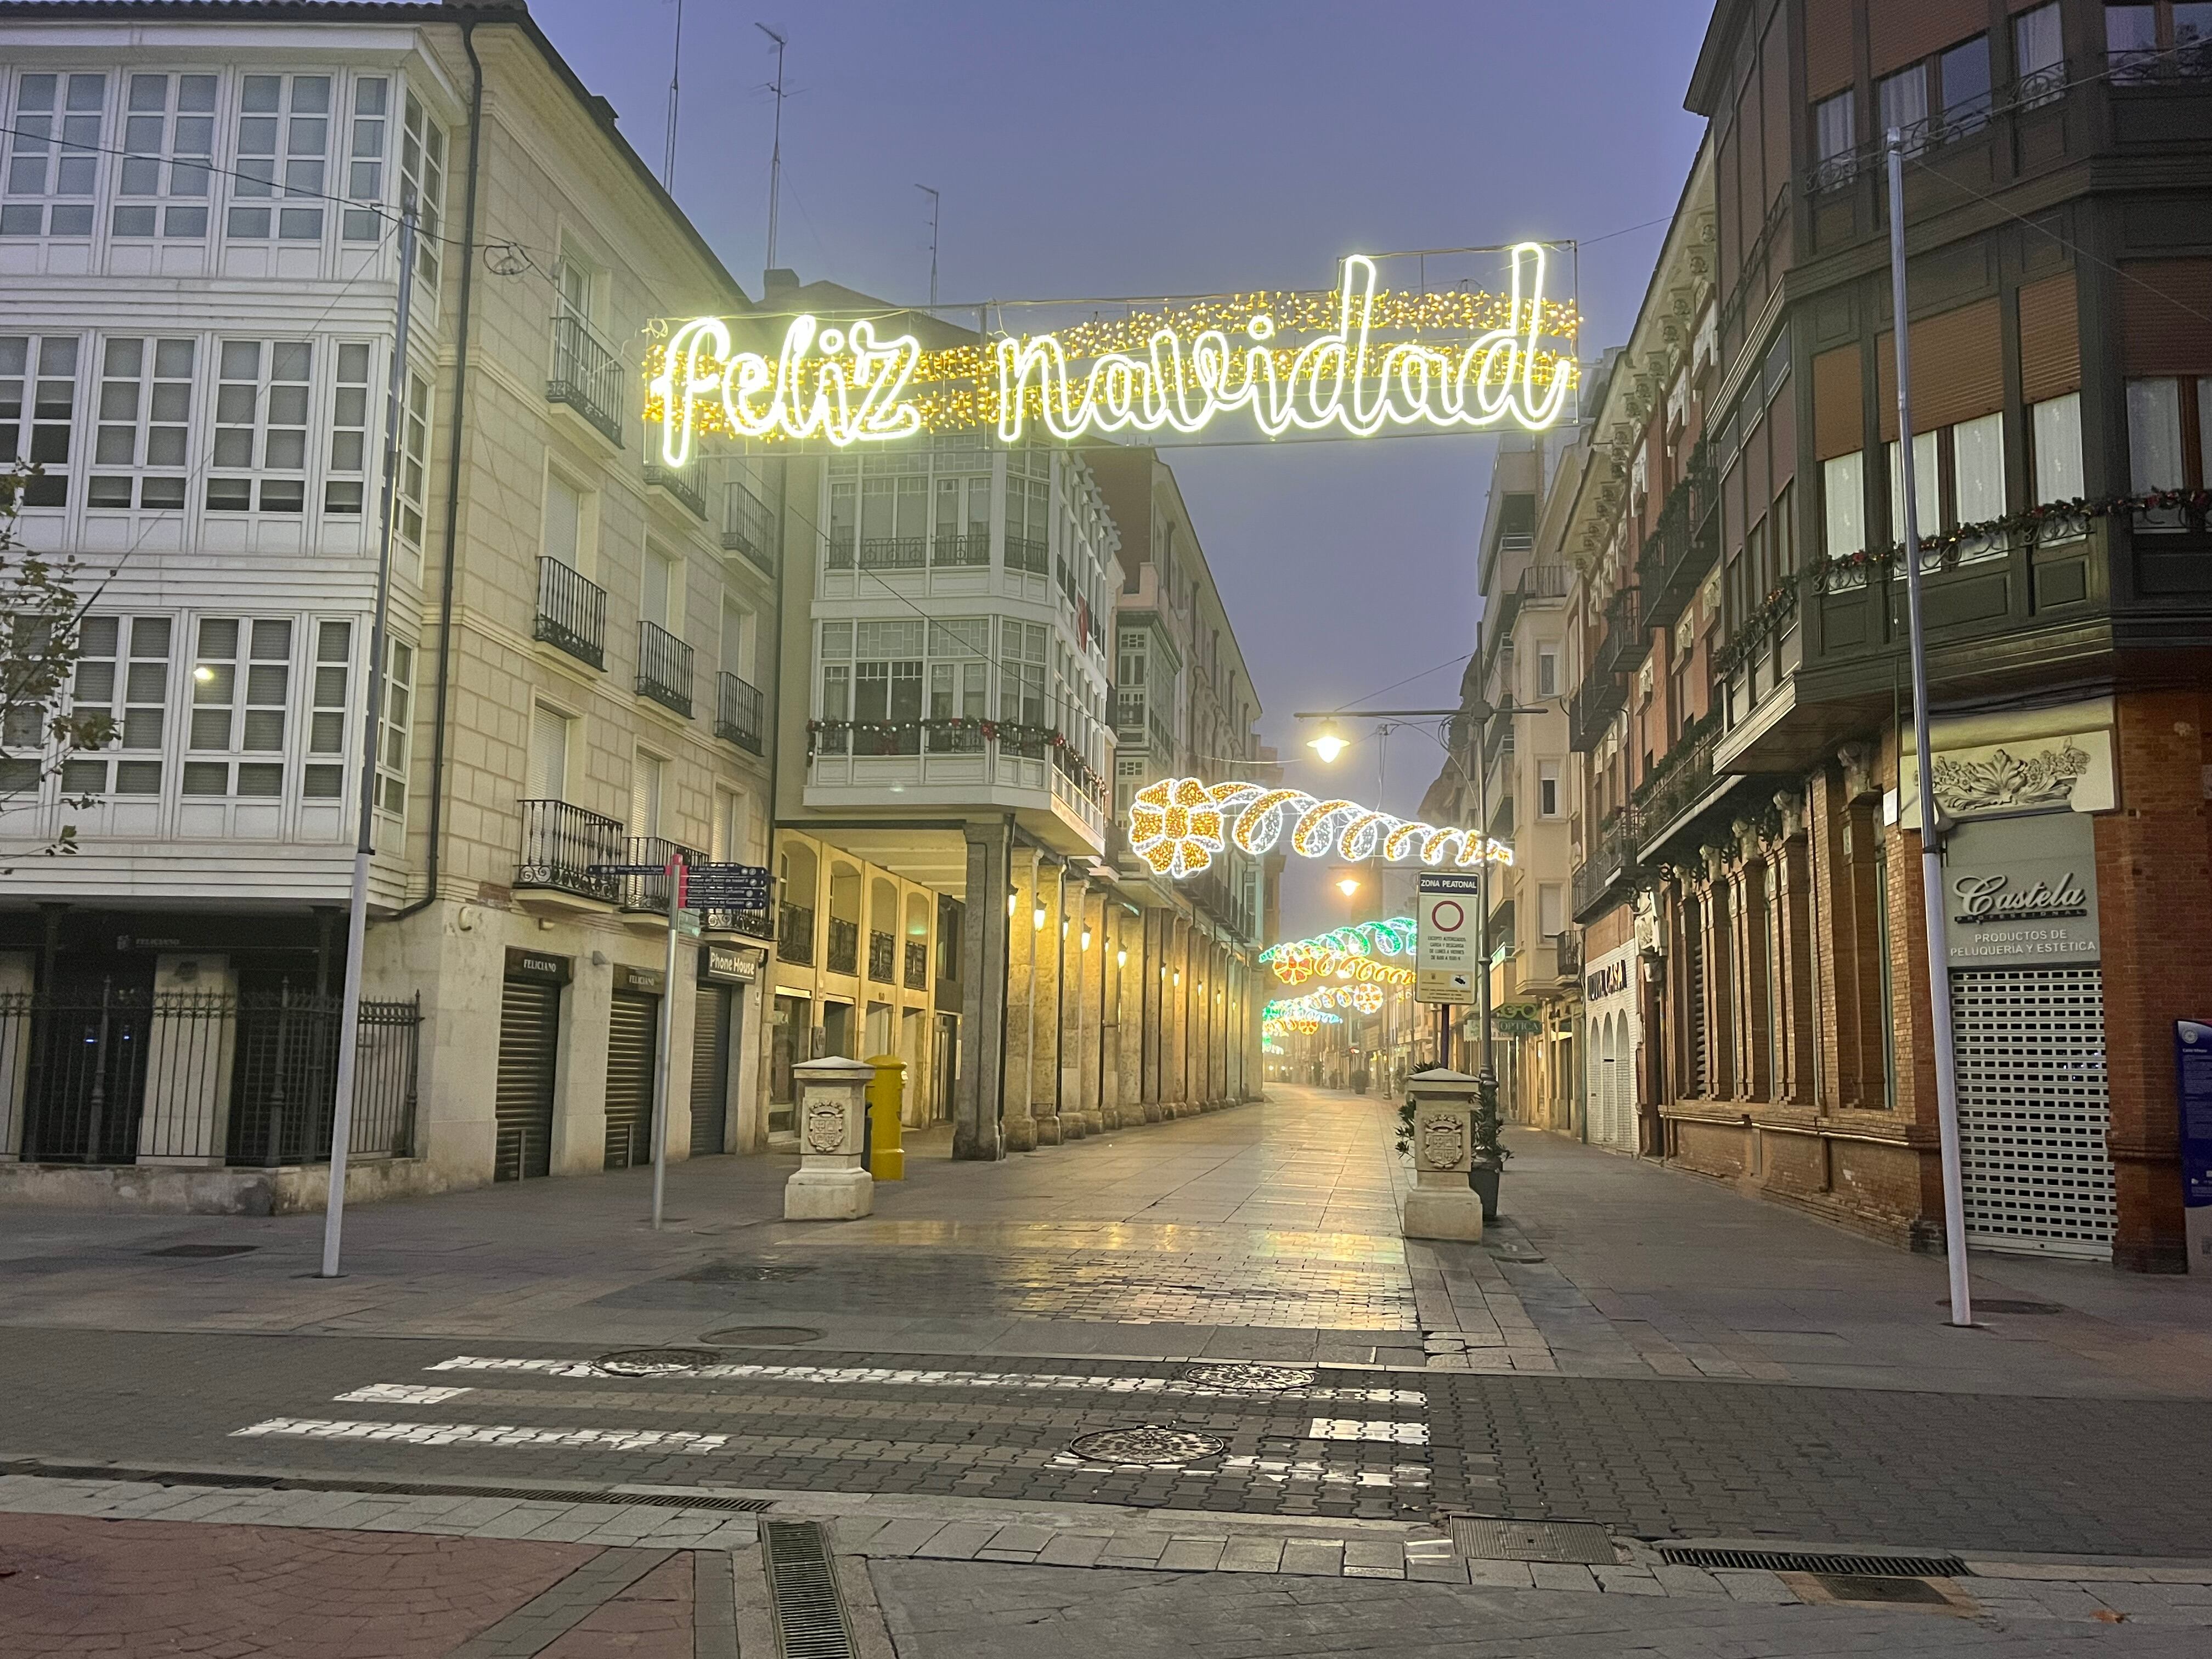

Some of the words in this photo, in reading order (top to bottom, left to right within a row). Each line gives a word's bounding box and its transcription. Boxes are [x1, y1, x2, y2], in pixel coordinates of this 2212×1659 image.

[998, 243, 1570, 441] navidad
[1442, 880, 1477, 889] PEATONAL
[1953, 872, 2086, 915] Castela
[1975, 931, 2047, 943] PRODUCTOS
[2051, 929, 2067, 939] DE
[1950, 944, 2024, 957] PELUQUERÍA
[2026, 944, 2034, 954] Y
[523, 959, 556, 972] FELICIANO
[710, 952, 733, 971] Phone
[733, 957, 754, 975] House
